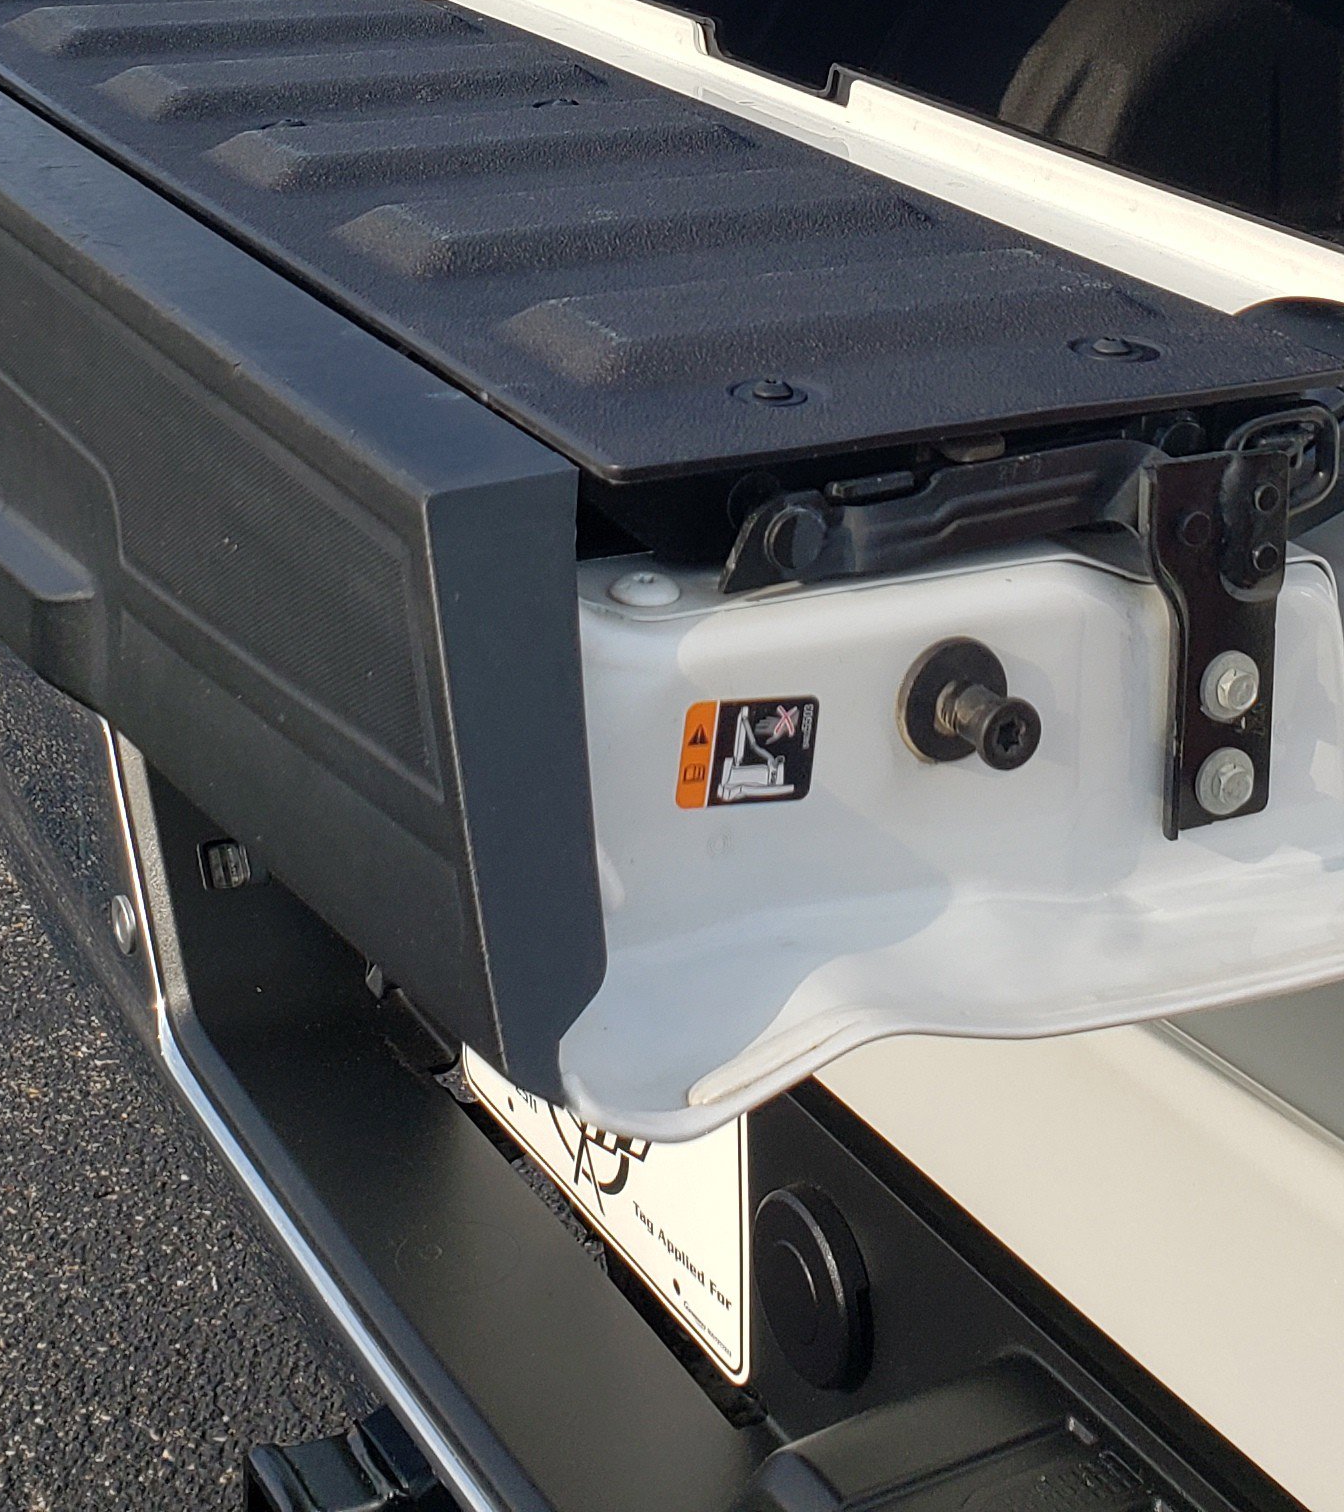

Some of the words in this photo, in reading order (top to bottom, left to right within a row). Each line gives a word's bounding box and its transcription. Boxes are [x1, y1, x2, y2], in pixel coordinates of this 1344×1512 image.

[632, 1200, 654, 1236] Tag
[658, 1228, 705, 1287] Applied
[709, 1279, 732, 1311] For
